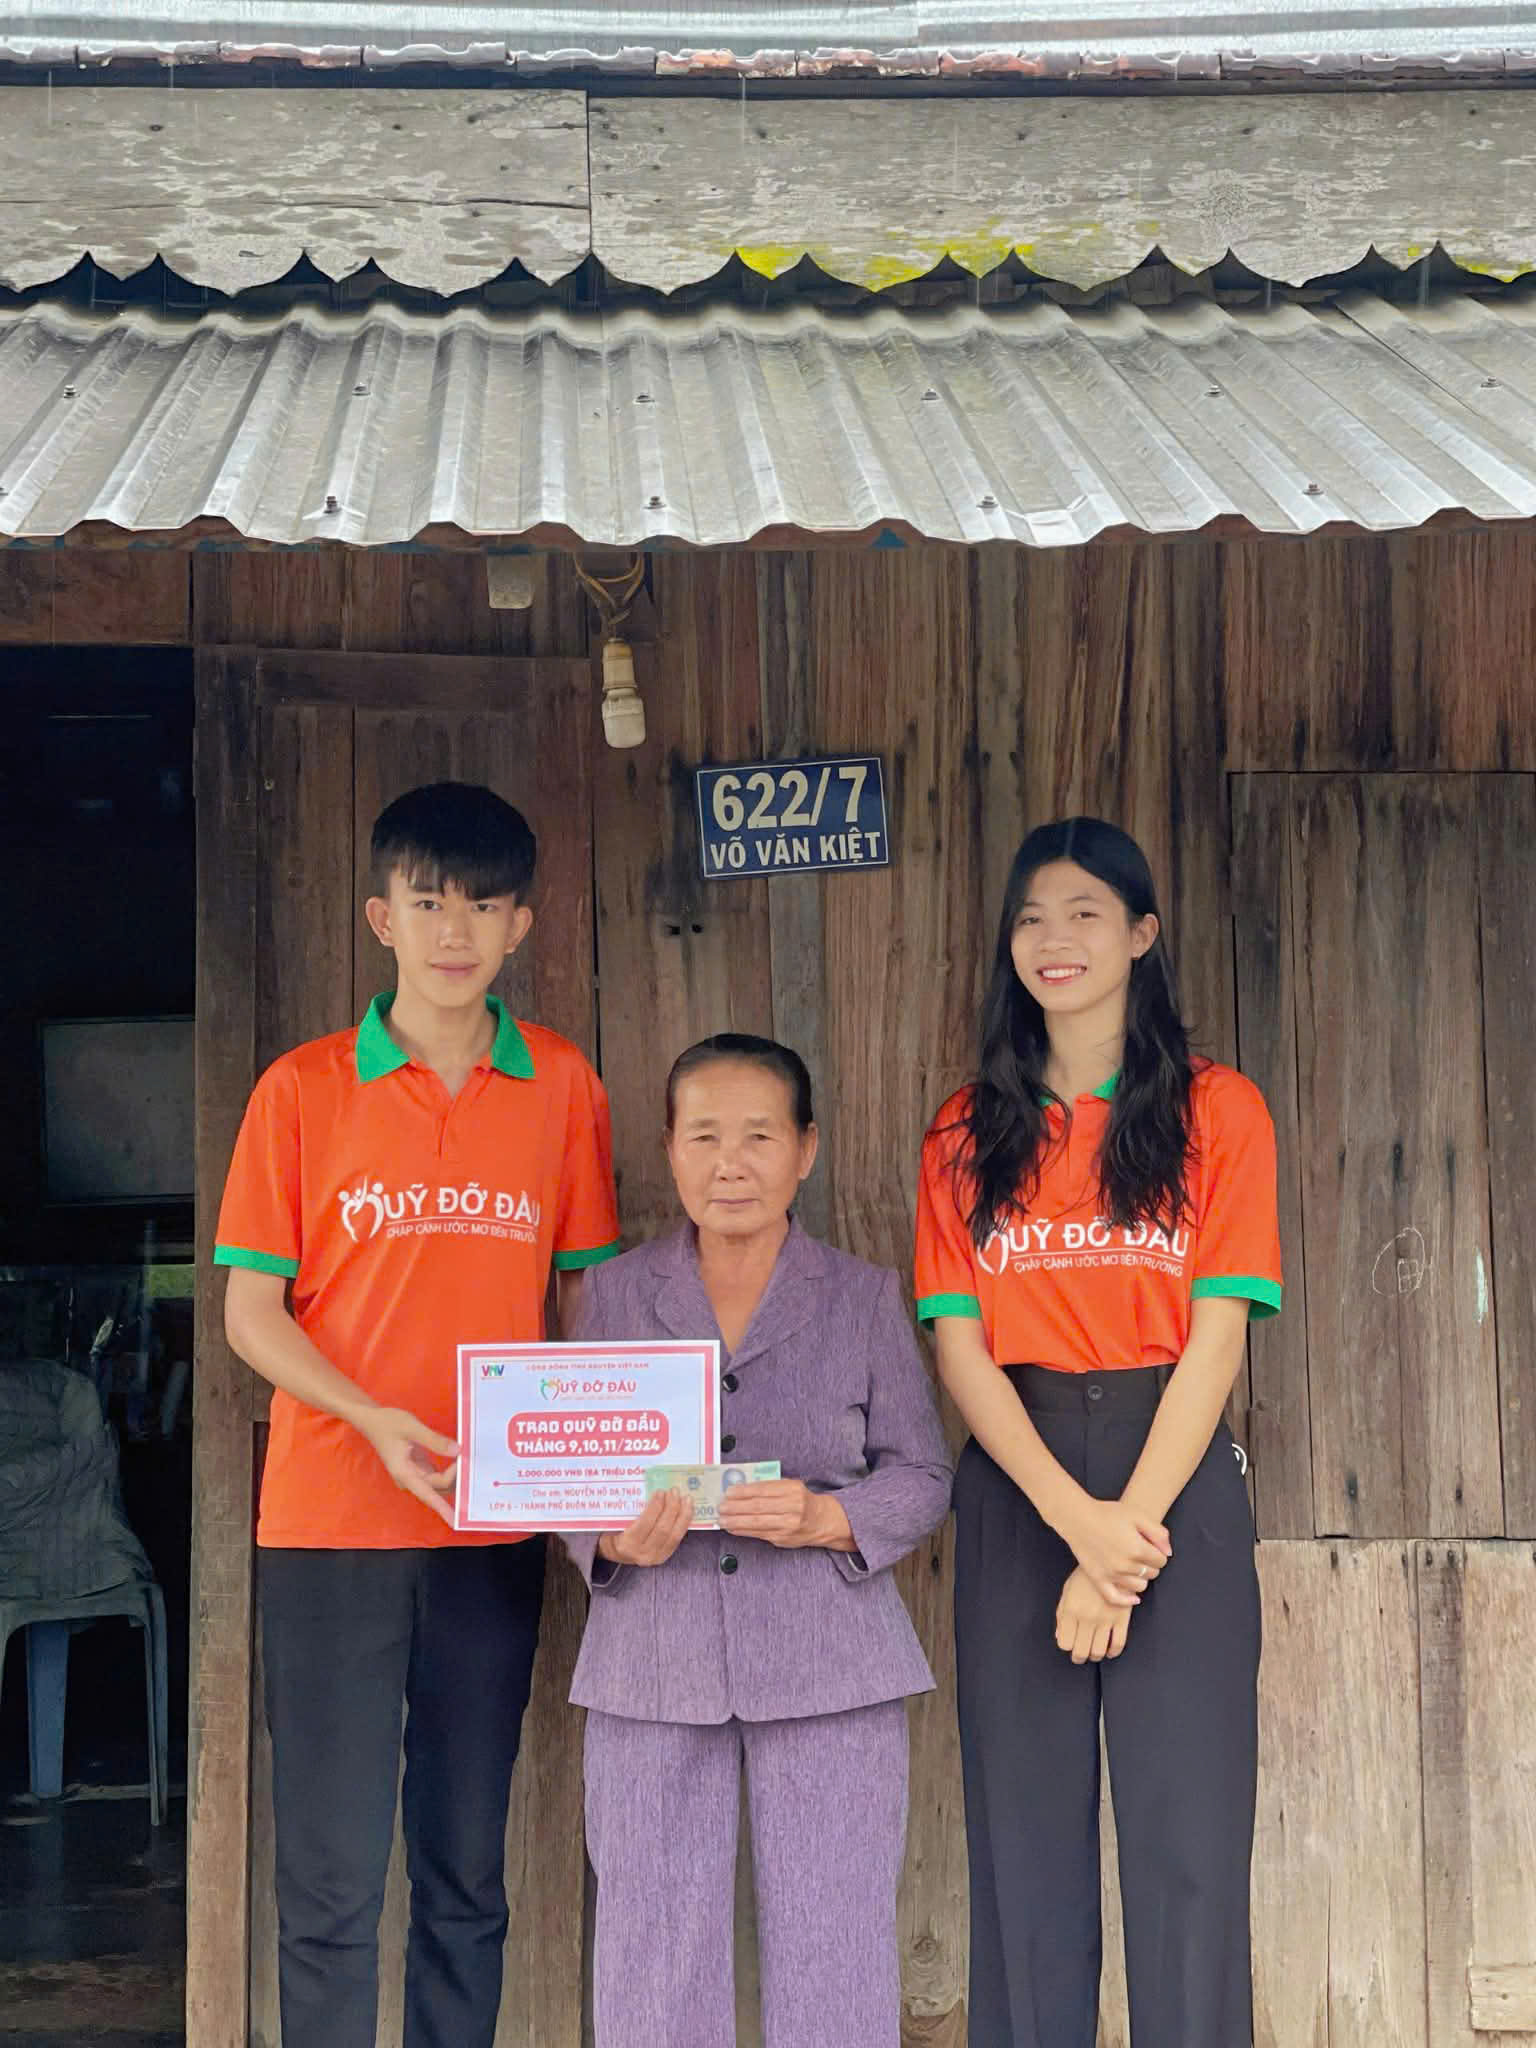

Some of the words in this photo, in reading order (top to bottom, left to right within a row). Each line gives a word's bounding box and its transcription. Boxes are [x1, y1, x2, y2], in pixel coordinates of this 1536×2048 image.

[713, 766, 868, 831] 622/7
[710, 836, 747, 869] VÕ
[755, 833, 811, 866] VĂN
[820, 827, 880, 863] KIỆT
[437, 1182, 489, 1215] ĐỠ
[516, 1421, 559, 1434] TRAO
[562, 1416, 597, 1434] QUỸ
[599, 1416, 623, 1433] ĐỠ
[626, 1411, 660, 1432] ĐẦU
[515, 1437, 566, 1454] THÁNG
[568, 1438, 660, 1454] 9,10,11/2024
